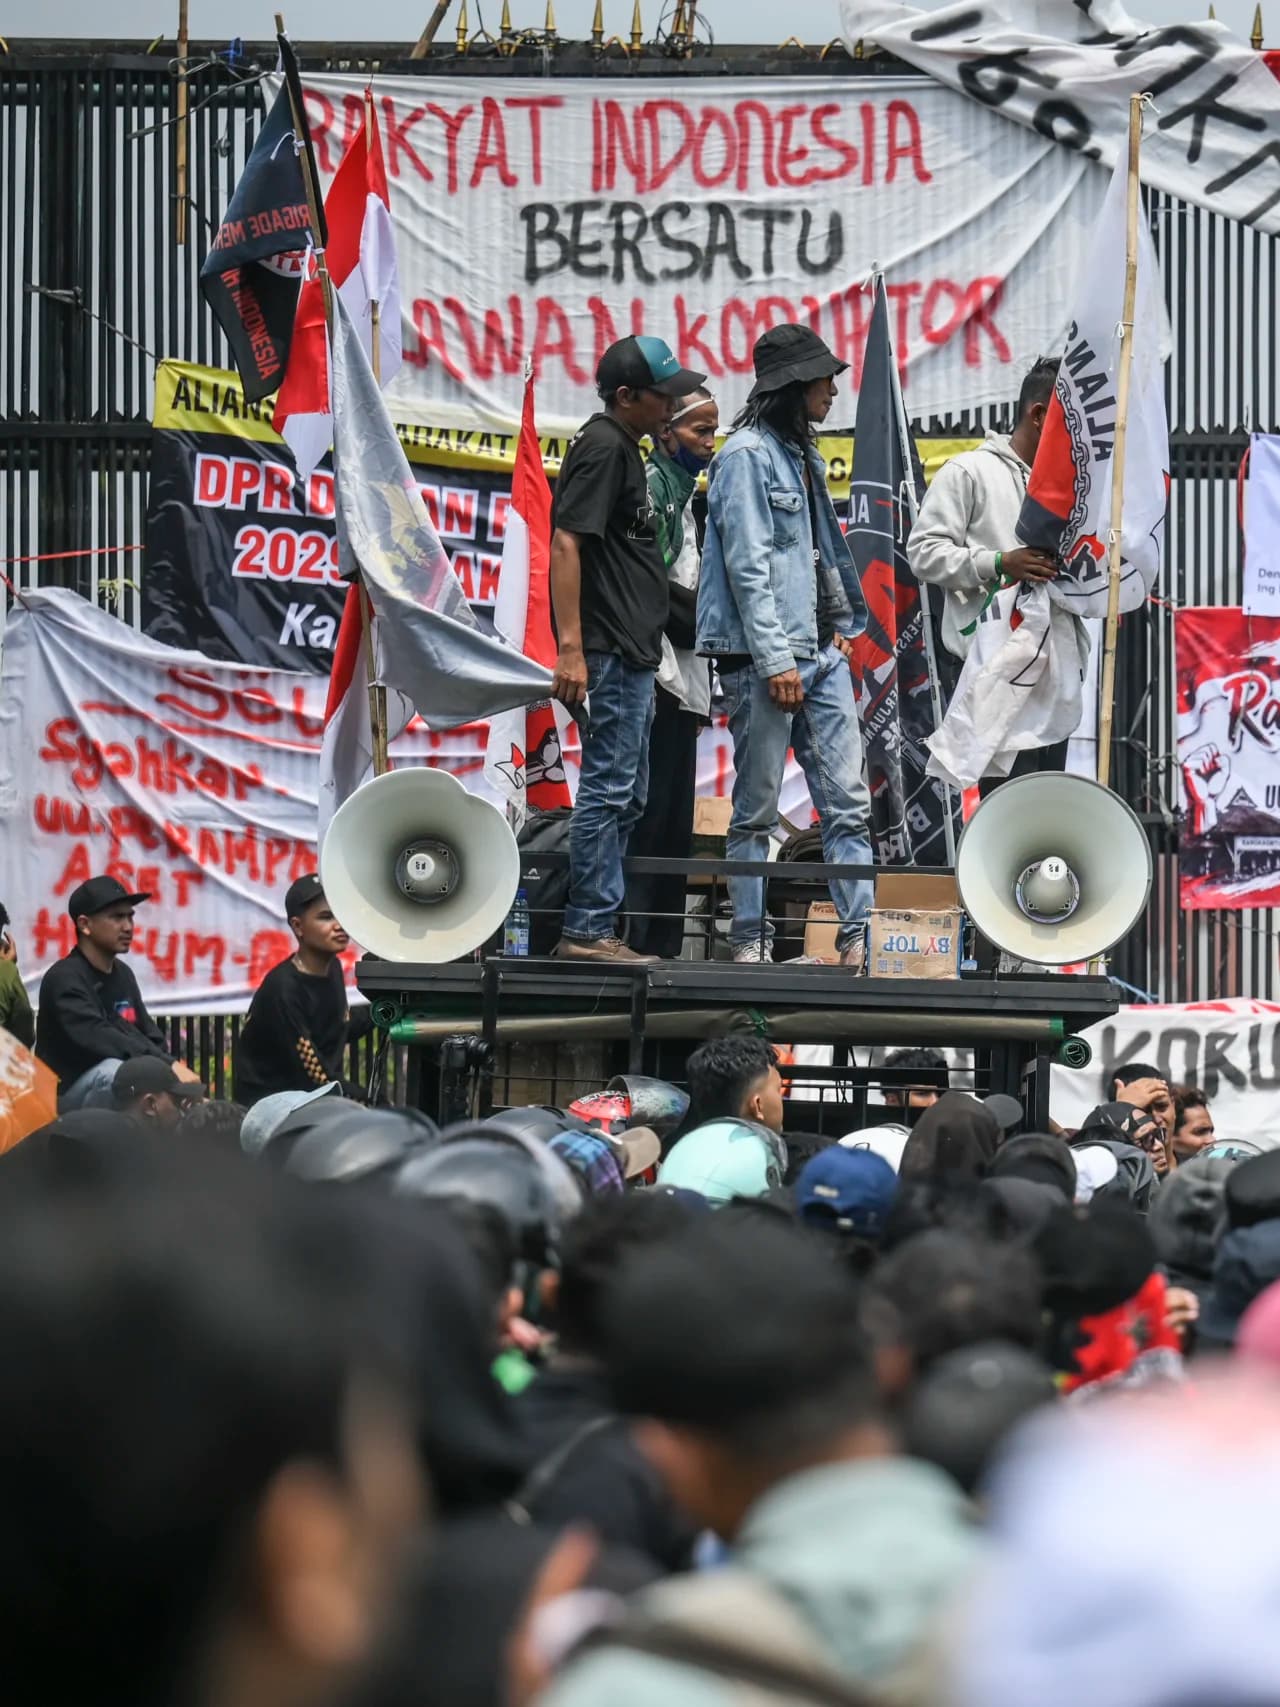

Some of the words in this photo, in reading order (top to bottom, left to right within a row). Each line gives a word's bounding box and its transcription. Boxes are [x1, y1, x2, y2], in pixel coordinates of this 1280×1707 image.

[592, 99, 932, 194] INDONESIA
[521, 201, 843, 286] BERSATU
[194, 453, 302, 515] DPR
[883, 935, 921, 954] TOP
